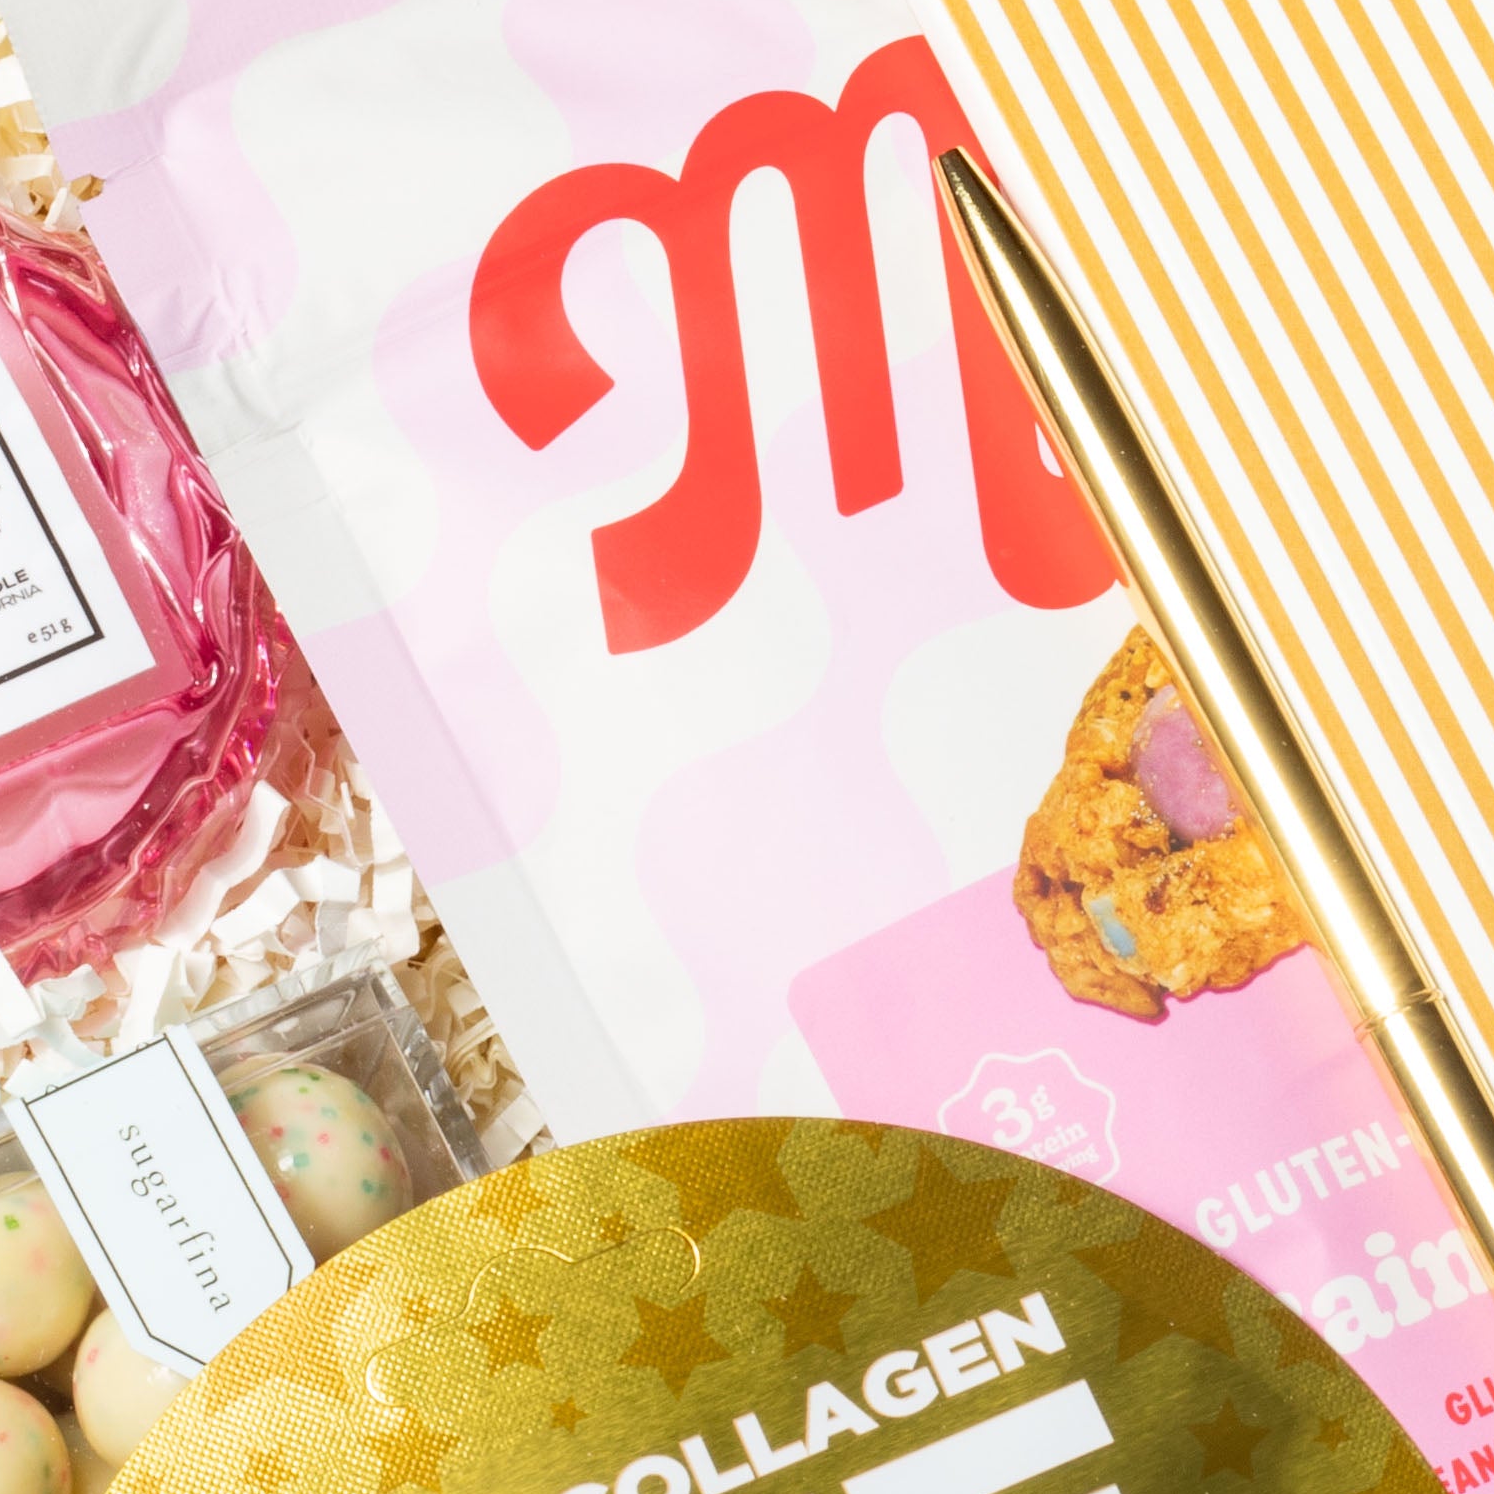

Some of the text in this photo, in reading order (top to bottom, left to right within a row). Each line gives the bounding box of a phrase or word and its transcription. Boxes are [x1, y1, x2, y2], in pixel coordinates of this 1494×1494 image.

[41, 625, 59, 642] 51
[61, 617, 73, 633] g
[982, 1085, 1056, 1148] 3g
[1020, 1123, 1088, 1160] tein
[119, 1124, 231, 1312] sugarfina
